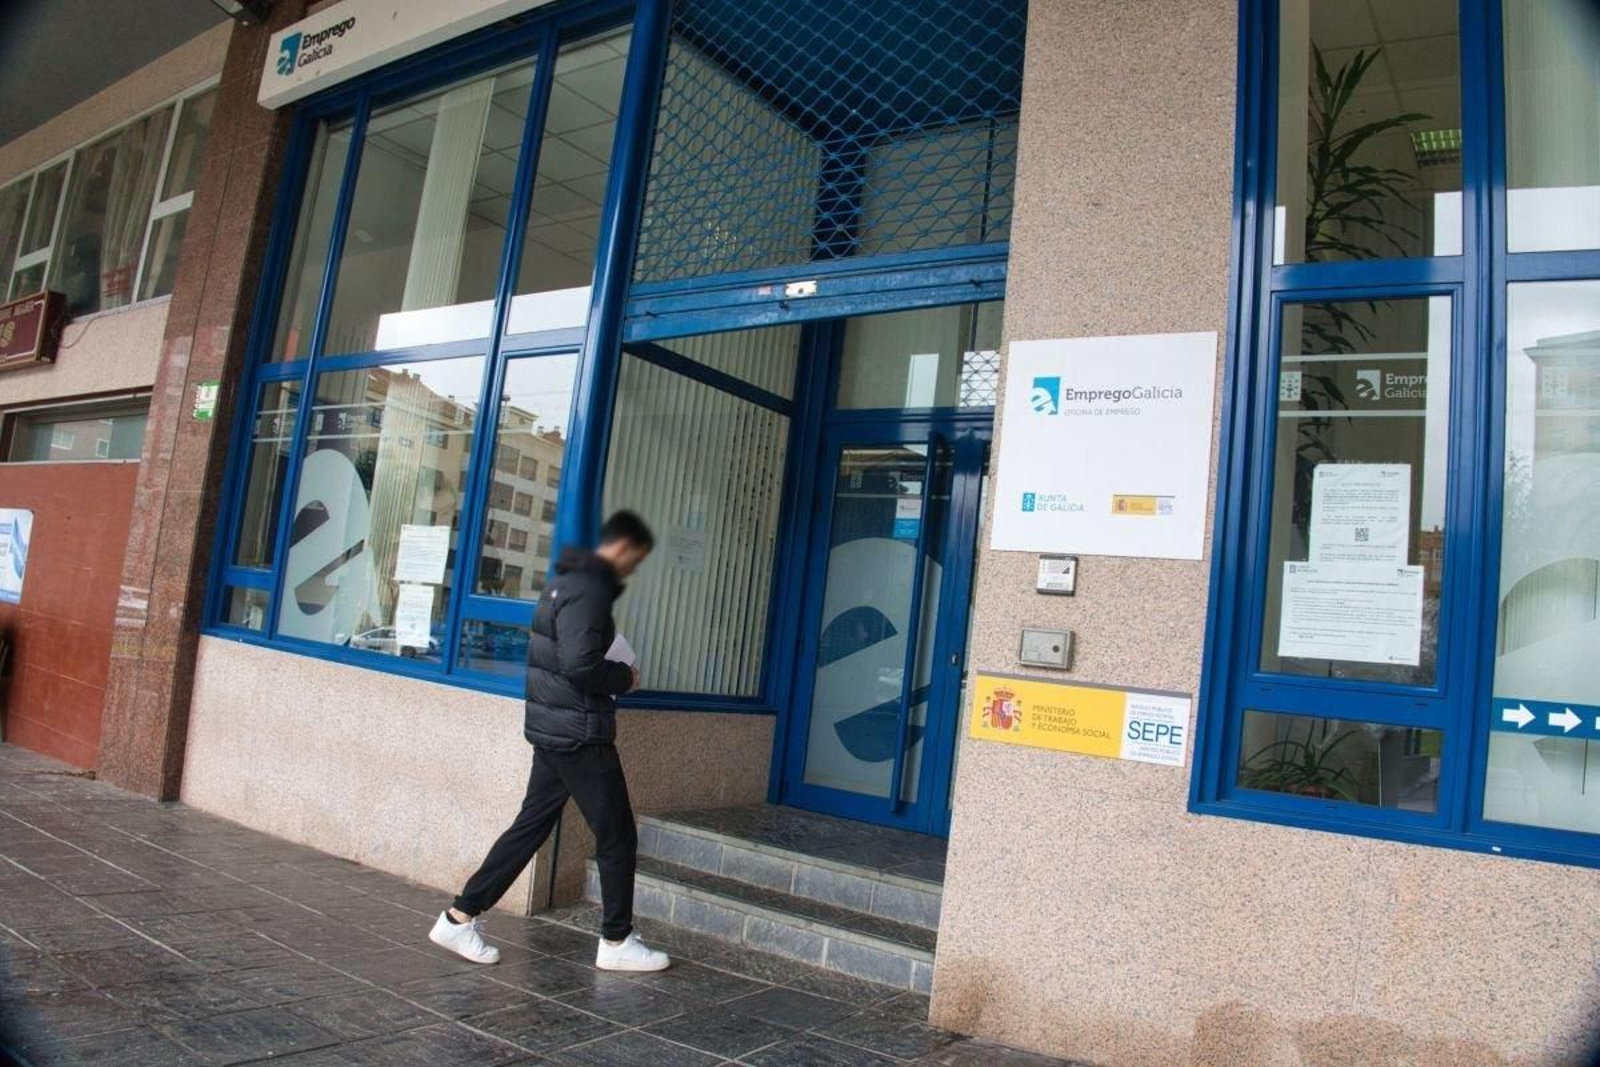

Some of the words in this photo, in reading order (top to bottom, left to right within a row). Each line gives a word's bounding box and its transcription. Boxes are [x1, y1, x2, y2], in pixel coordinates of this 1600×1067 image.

[302, 17, 356, 49] Emprego
[298, 45, 333, 67] Galicia
[1385, 373, 1428, 387] Empr
[1066, 386, 1183, 403] EmpregoGalicia
[1064, 408, 1092, 417] OFICINA
[1094, 408, 1103, 416] DE
[1105, 407, 1141, 416] EMPREGO
[1037, 494, 1067, 503] XUNTA
[1037, 503, 1048, 512] DE
[1049, 503, 1085, 512] GALICIA
[1033, 705, 1076, 717] MINISTERIO
[1032, 713, 1043, 721] DE
[1044, 715, 1077, 726] TRABAJO
[1082, 728, 1112, 739] SOCIAL
[1127, 720, 1183, 745] SEPE
